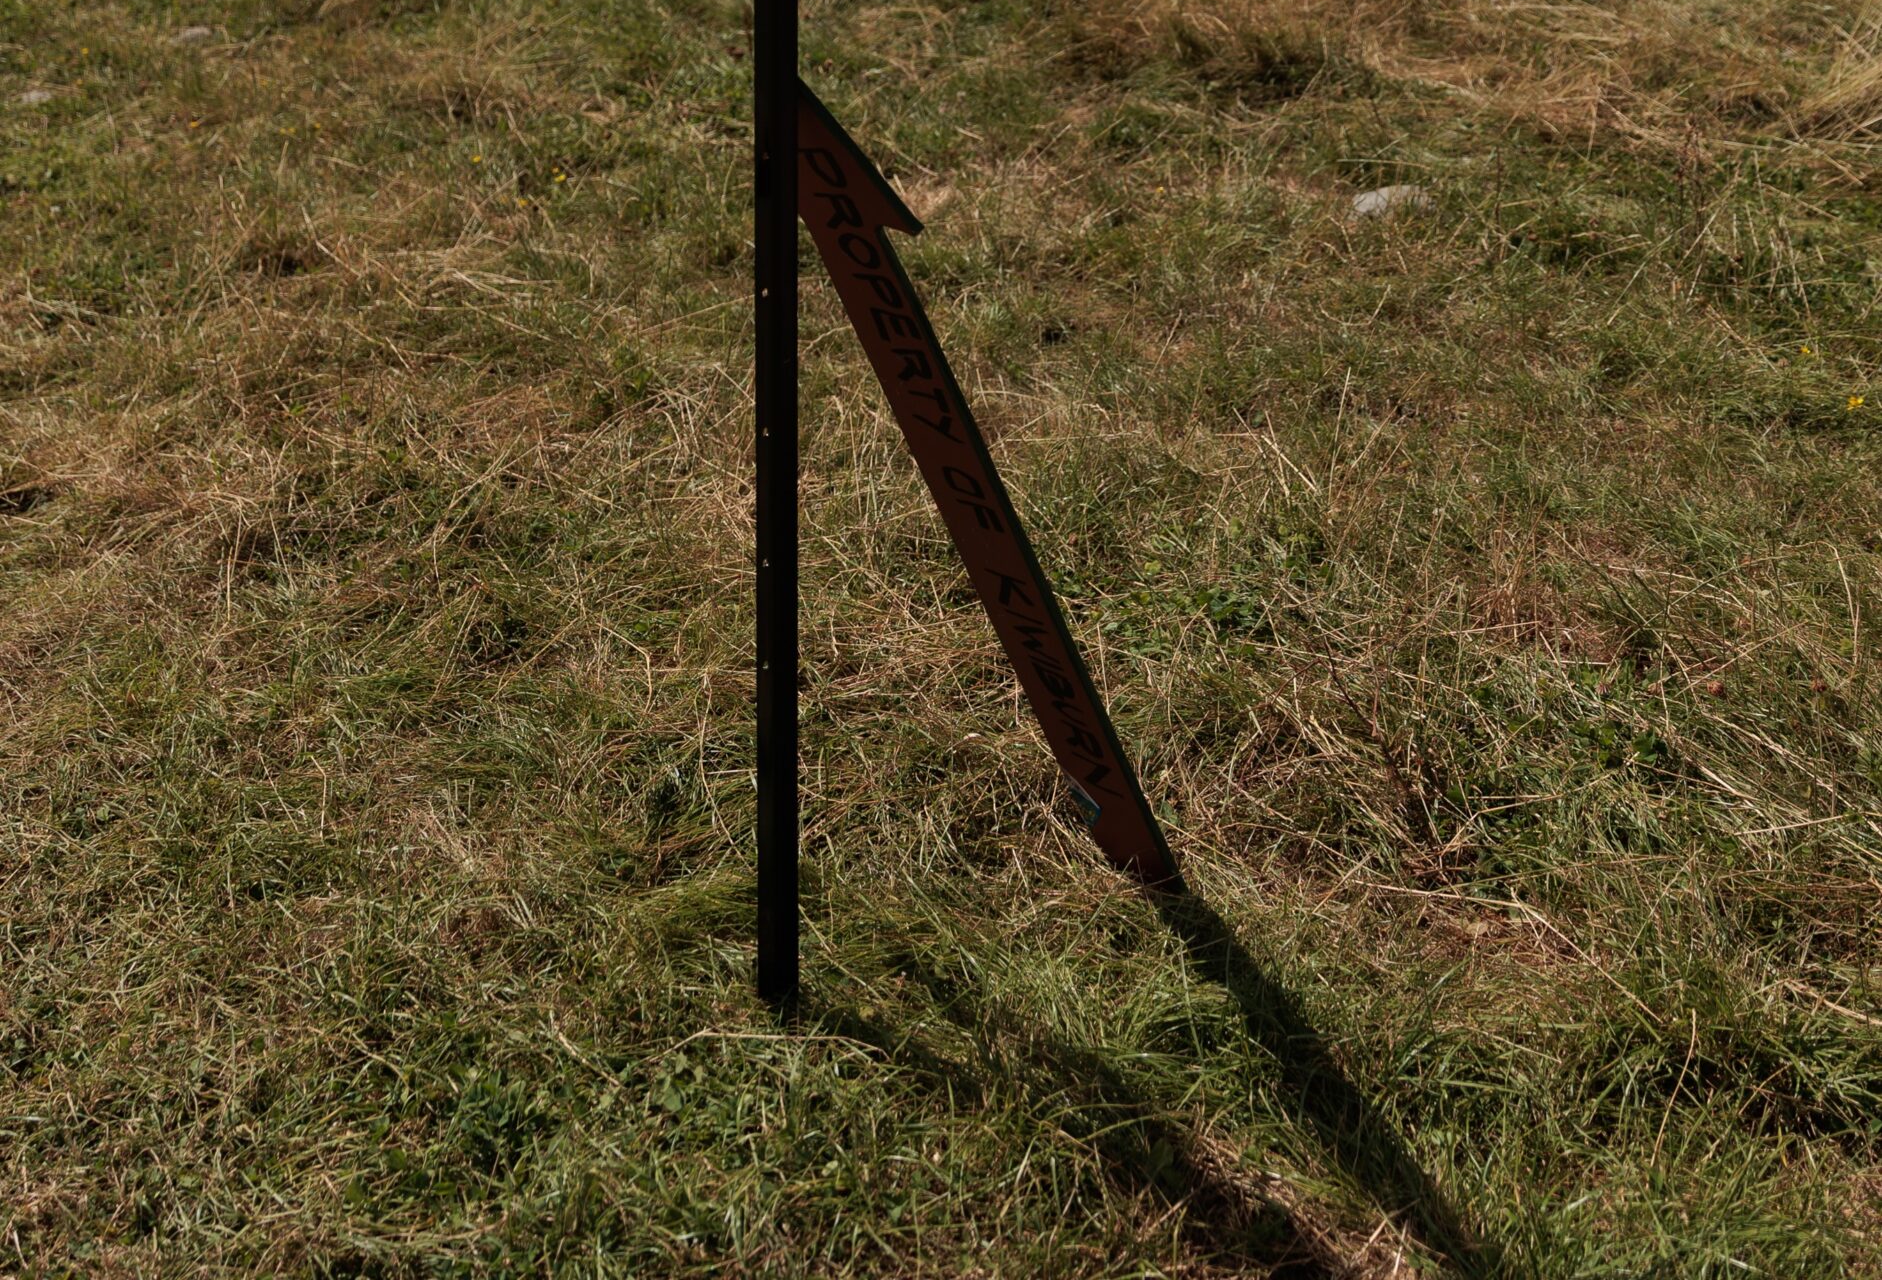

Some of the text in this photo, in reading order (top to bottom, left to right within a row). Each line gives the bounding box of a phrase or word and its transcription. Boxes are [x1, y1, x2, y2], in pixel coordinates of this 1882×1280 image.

[799, 146, 1125, 799] PROPERTY OF KIWIBURN
